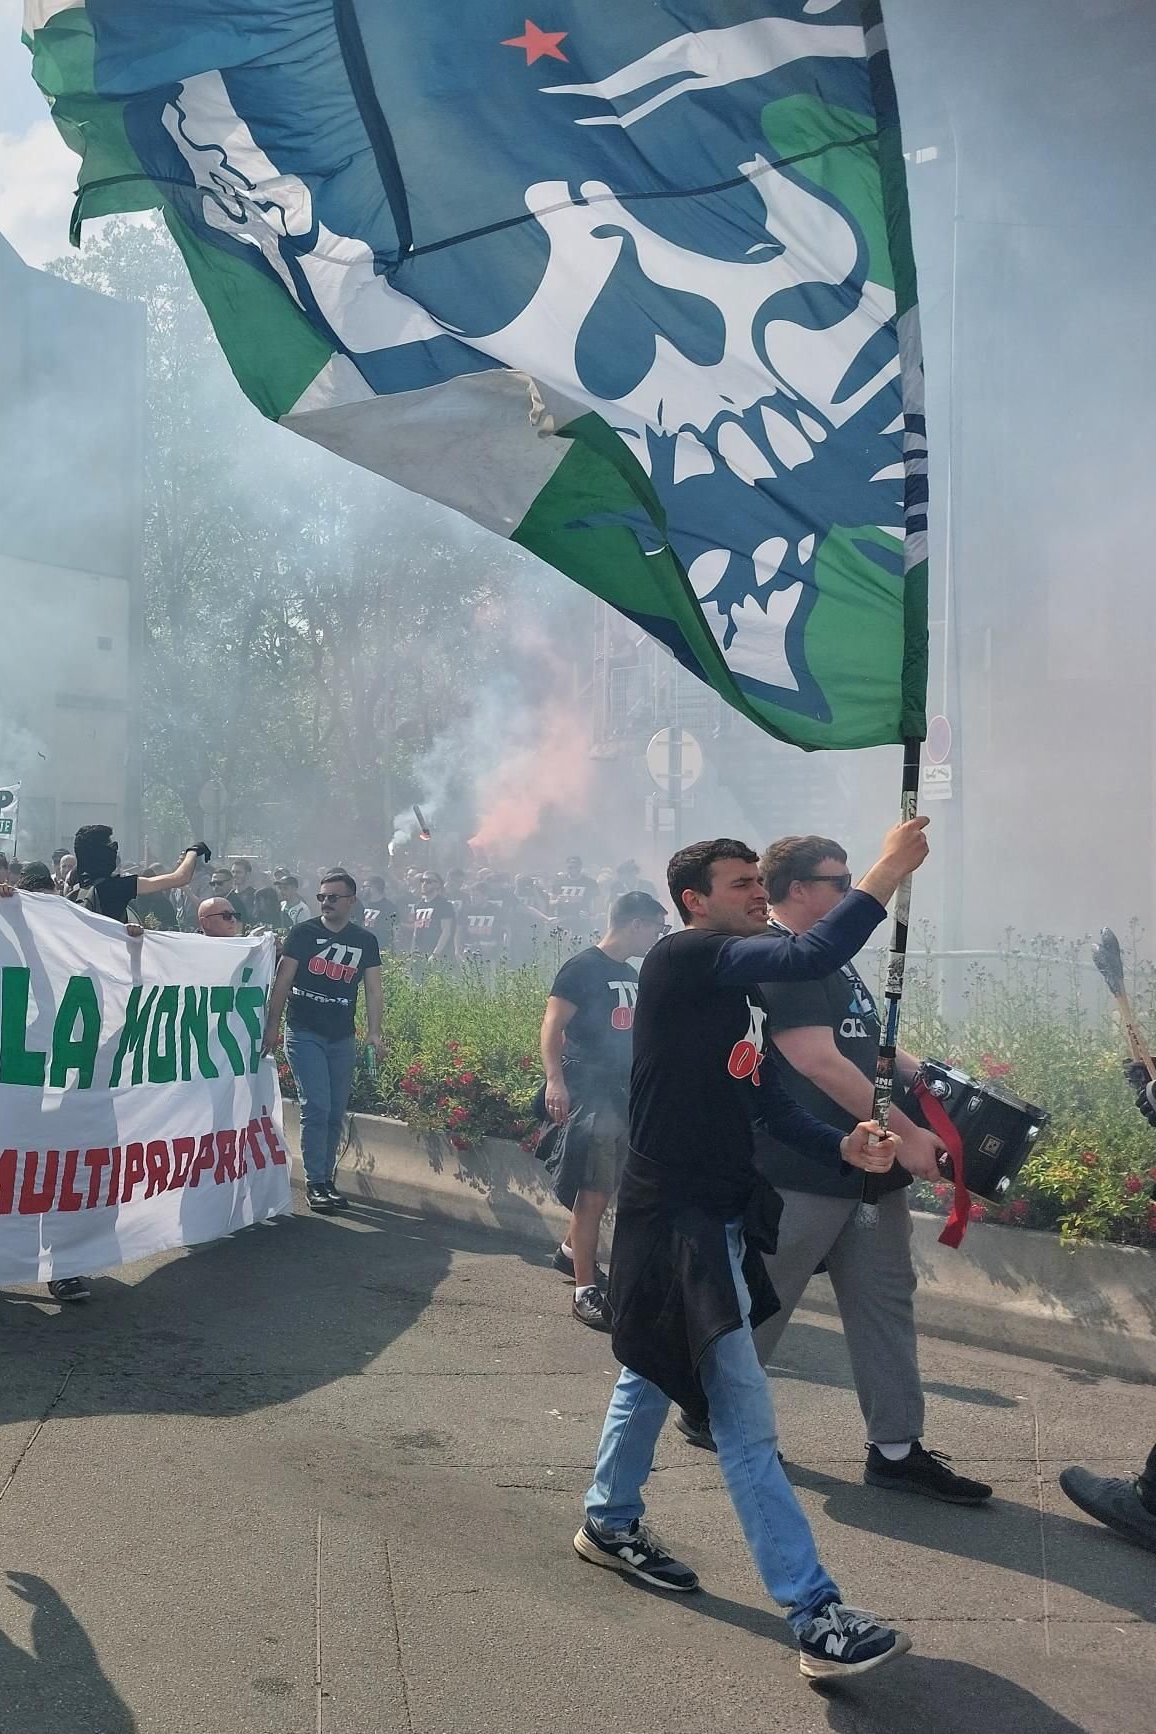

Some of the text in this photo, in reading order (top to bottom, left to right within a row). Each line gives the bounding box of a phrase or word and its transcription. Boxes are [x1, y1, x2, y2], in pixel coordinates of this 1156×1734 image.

[308, 956, 358, 984] OUT
[0, 966, 102, 1090] LA
[109, 967, 270, 1089] MONTÉ
